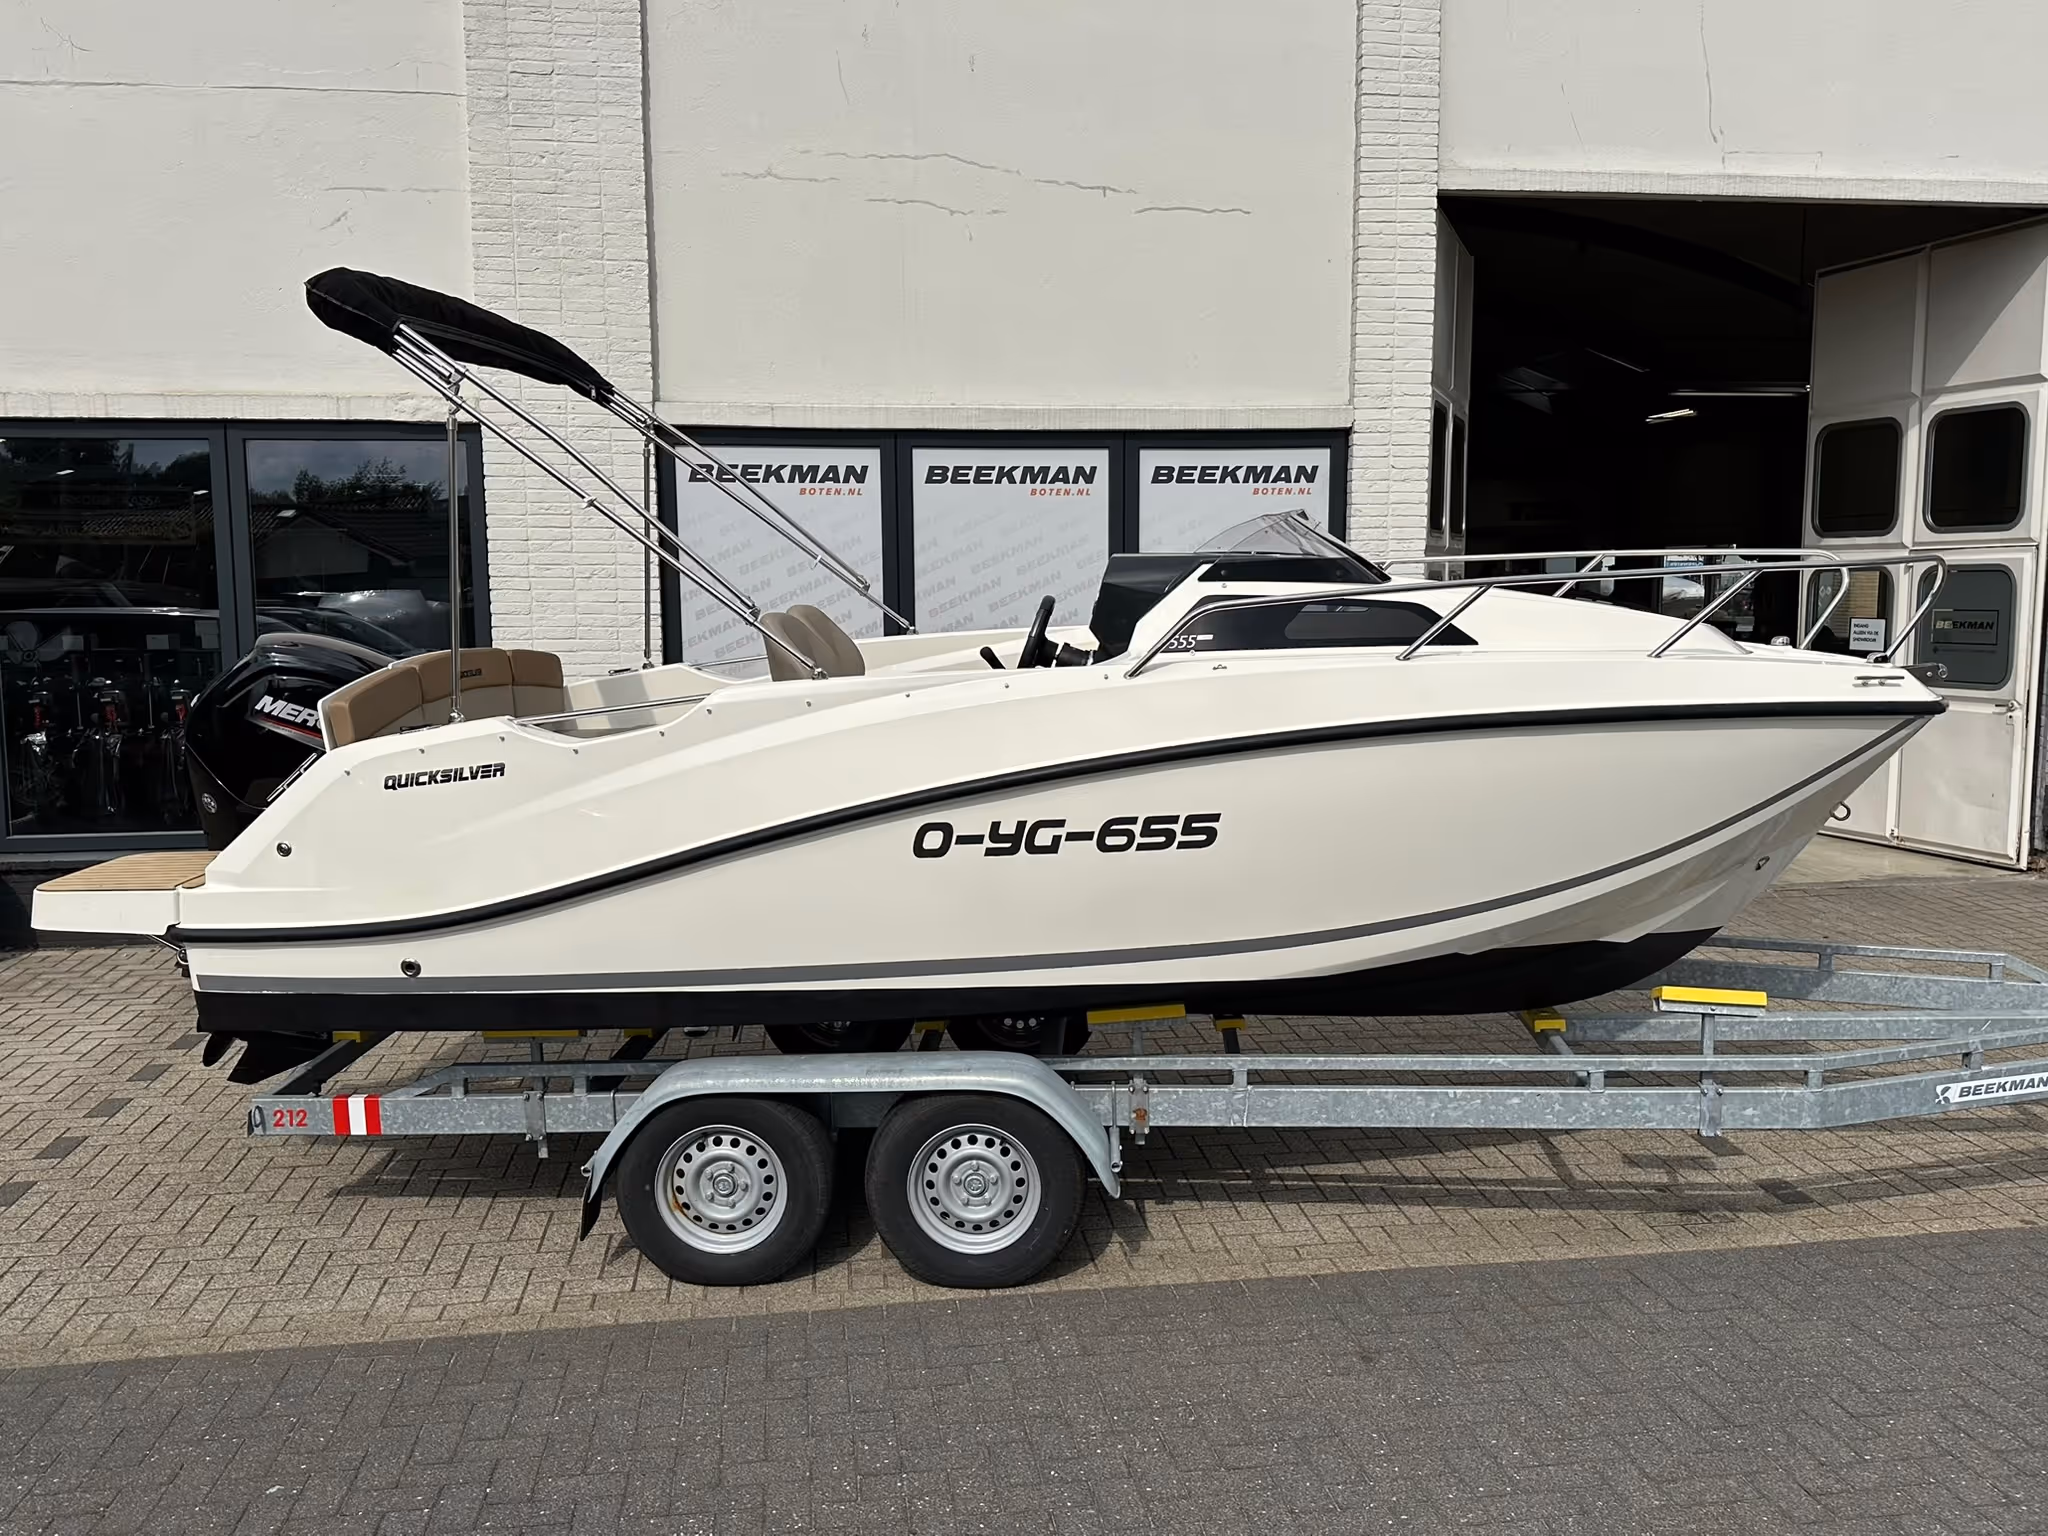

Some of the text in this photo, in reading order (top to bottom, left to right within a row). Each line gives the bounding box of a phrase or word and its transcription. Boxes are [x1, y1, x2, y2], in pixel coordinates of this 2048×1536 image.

[688, 463, 869, 484] BEEKMAN
[924, 465, 1098, 485] BEEKMAN
[1150, 465, 1319, 484] BEEKMAN
[798, 487, 863, 496] BOTEN.NL
[1030, 488, 1091, 497] BOTEN.NL
[1252, 487, 1313, 496] BOTEN.NL
[1935, 620, 1995, 631] BEEKMAN
[383, 762, 506, 791] QUICKSILVER
[1958, 1076, 2048, 1098] BEEKMAN
[272, 1109, 308, 1128] 212
